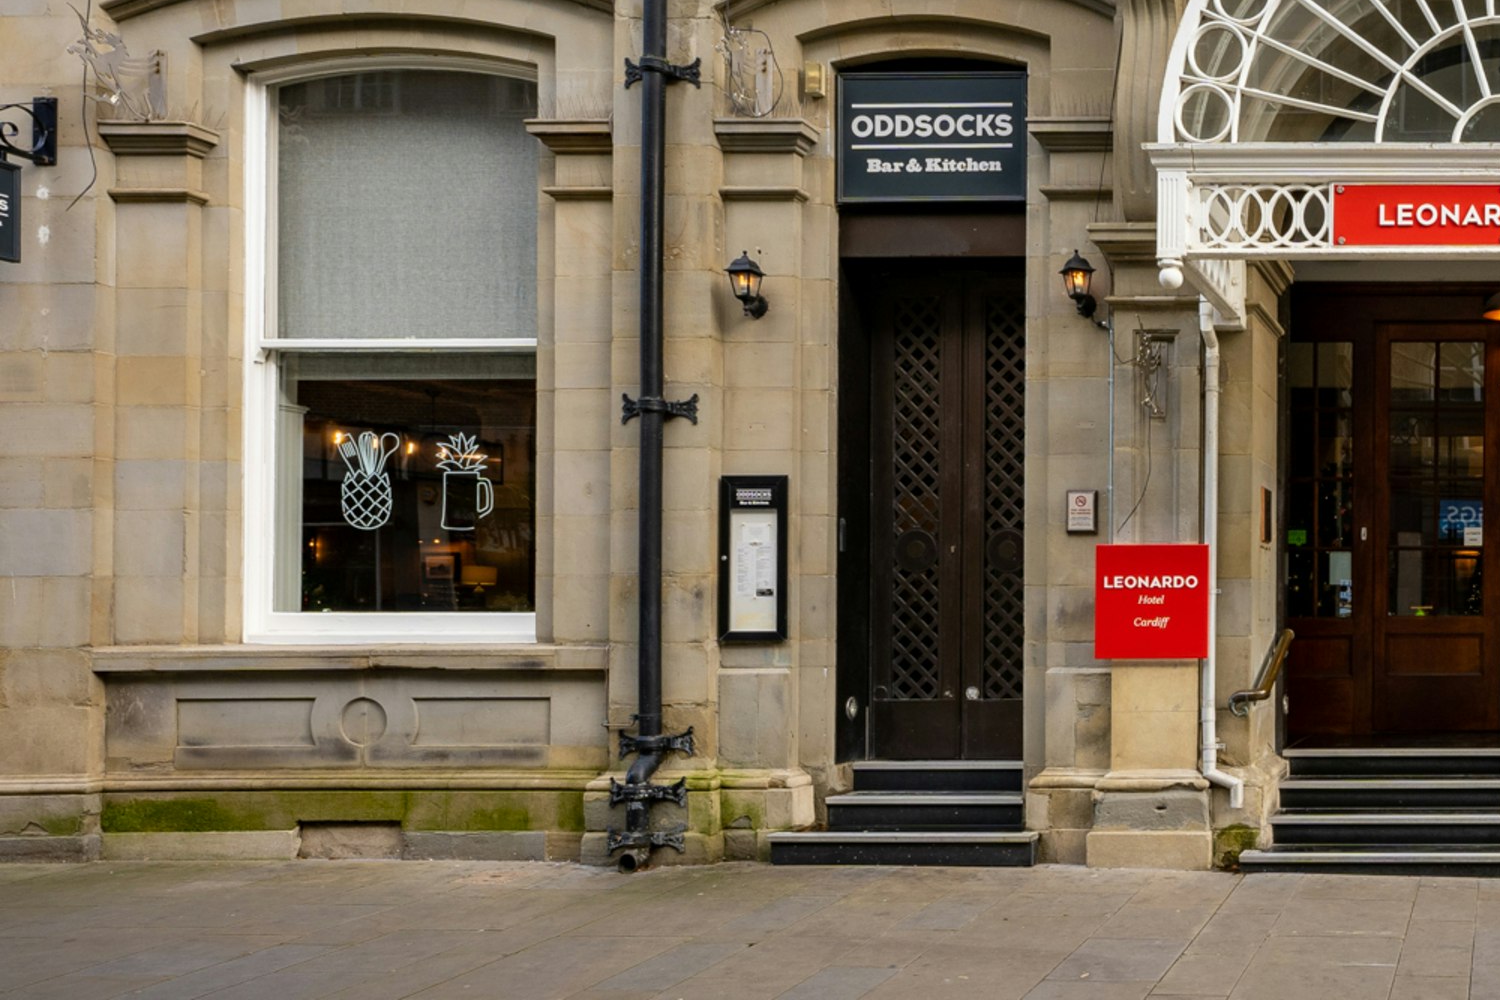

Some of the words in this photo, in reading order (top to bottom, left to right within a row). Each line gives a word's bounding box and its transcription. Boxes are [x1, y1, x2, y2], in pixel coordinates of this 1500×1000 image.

[851, 113, 1013, 138] ODDSOCKS
[866, 158, 904, 173] Bar
[905, 158, 922, 173] &
[925, 157, 1002, 173] Kitchen
[1103, 575, 1198, 589] LEONARDO
[1137, 595, 1164, 605] Hotel
[1133, 617, 1170, 628] Cardiff
